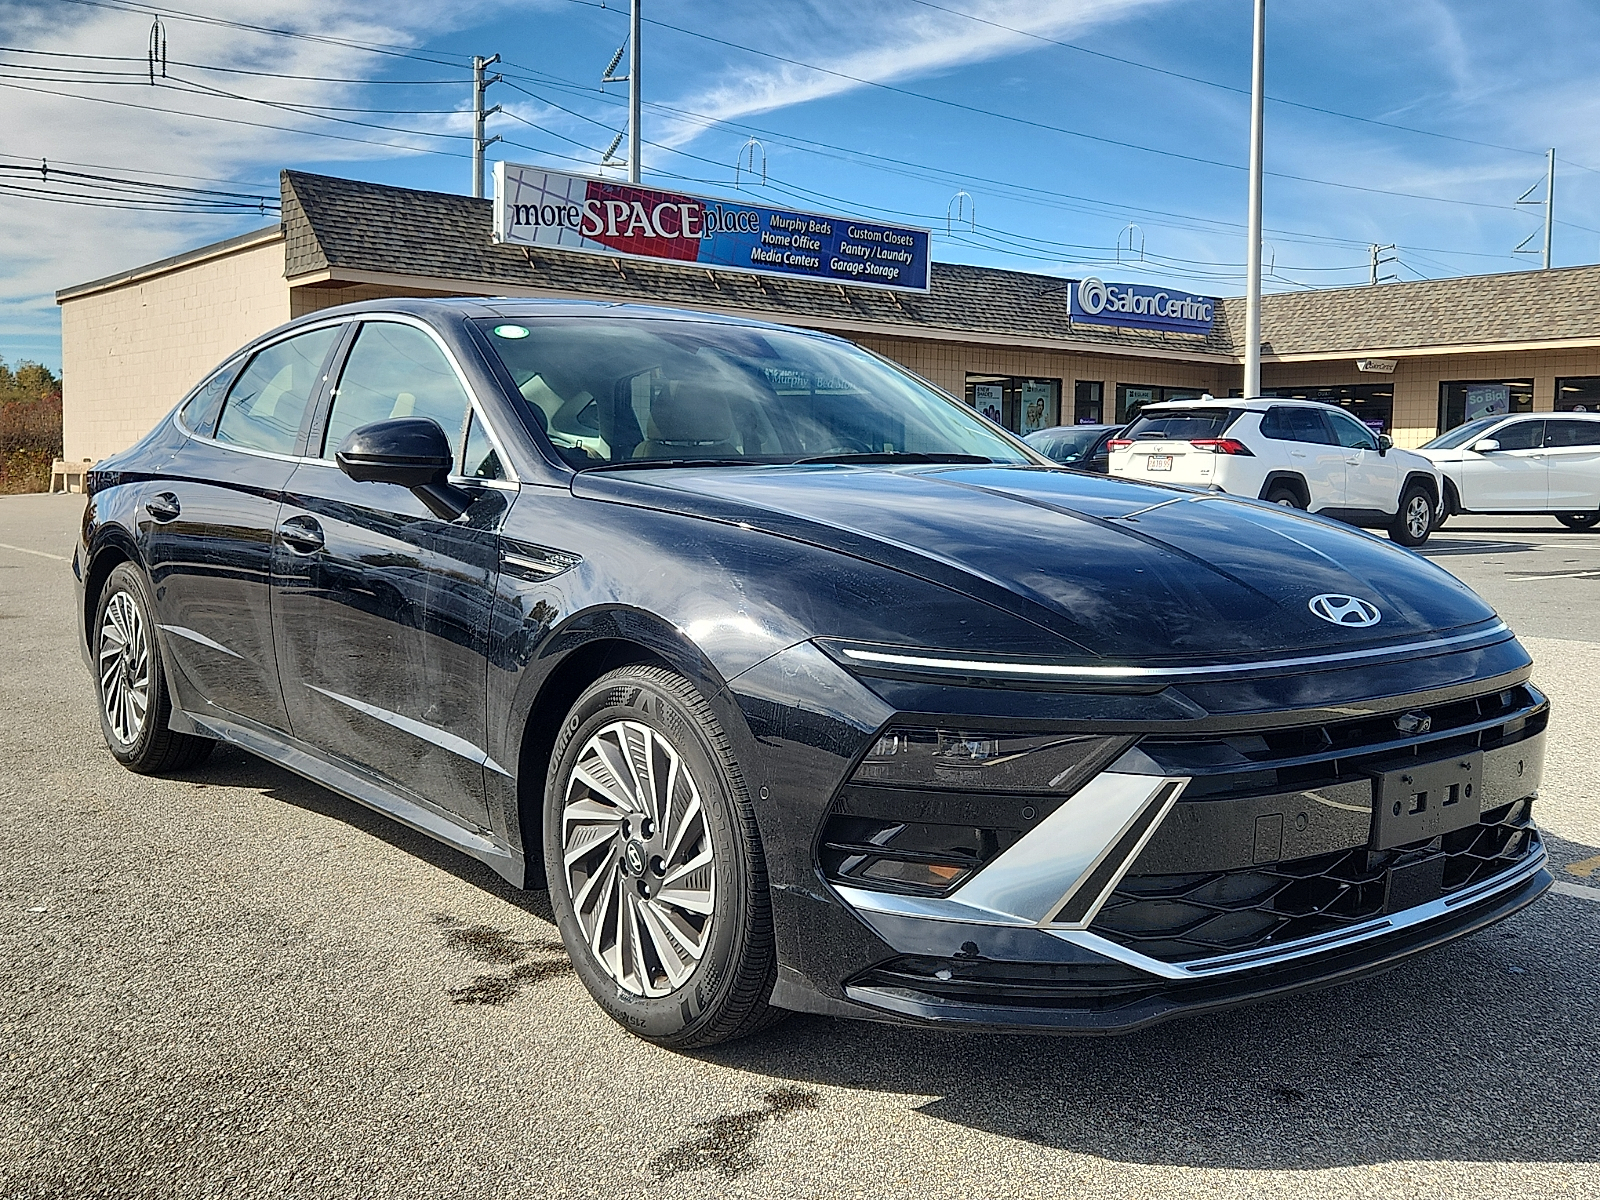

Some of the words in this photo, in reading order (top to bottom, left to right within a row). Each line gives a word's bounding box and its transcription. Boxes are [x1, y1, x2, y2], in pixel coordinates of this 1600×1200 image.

[769, 214, 807, 233] Murphy
[808, 221, 831, 235] Beds
[761, 230, 790, 246] Home
[791, 234, 821, 250] Office
[848, 226, 882, 242] Custom
[883, 230, 914, 246] Closets
[751, 247, 782, 263] Media
[783, 251, 819, 268] Centers
[840, 241, 871, 259] Pantry
[876, 246, 913, 265] Laundry
[830, 257, 864, 275] Garage
[864, 261, 899, 279] Storage
[1105, 286, 1212, 322] SalonCentric
[772, 375, 809, 389] Murphy
[1469, 395, 1483, 404] So
[1485, 389, 1506, 402] Big!
[547, 713, 580, 791] KUMHO
